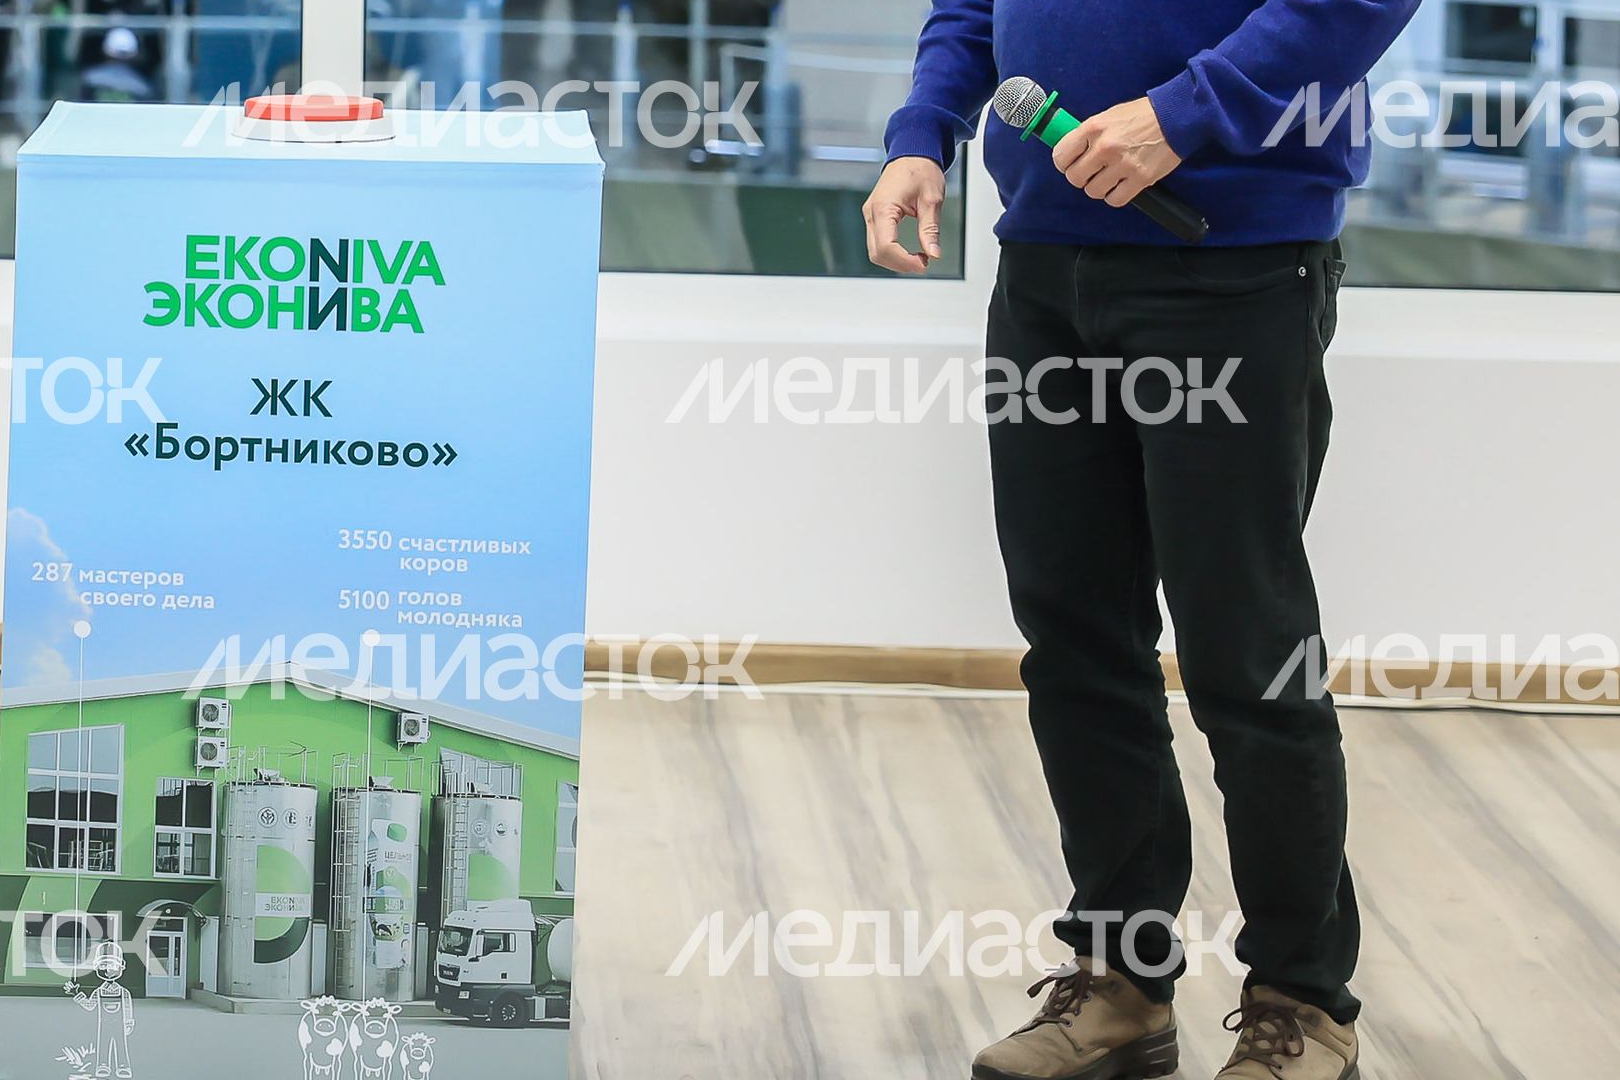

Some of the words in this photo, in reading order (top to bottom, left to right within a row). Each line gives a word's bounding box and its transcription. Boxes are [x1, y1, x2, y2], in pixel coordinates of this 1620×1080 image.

[185, 234, 447, 286] EKONIVA
[142, 281, 425, 334] ЭКОНИВА
[249, 377, 333, 418] ЖК
[123, 422, 458, 471] «Бортниково»
[337, 528, 393, 550] 3550
[398, 537, 532, 555] счастливых
[31, 561, 74, 582] 287
[79, 568, 185, 590] мастеров
[399, 556, 469, 576] коров
[80, 590, 157, 607] своего
[161, 594, 216, 611] дела
[337, 588, 390, 610] 5100
[397, 591, 463, 606] голов
[397, 610, 524, 629] молодняка
